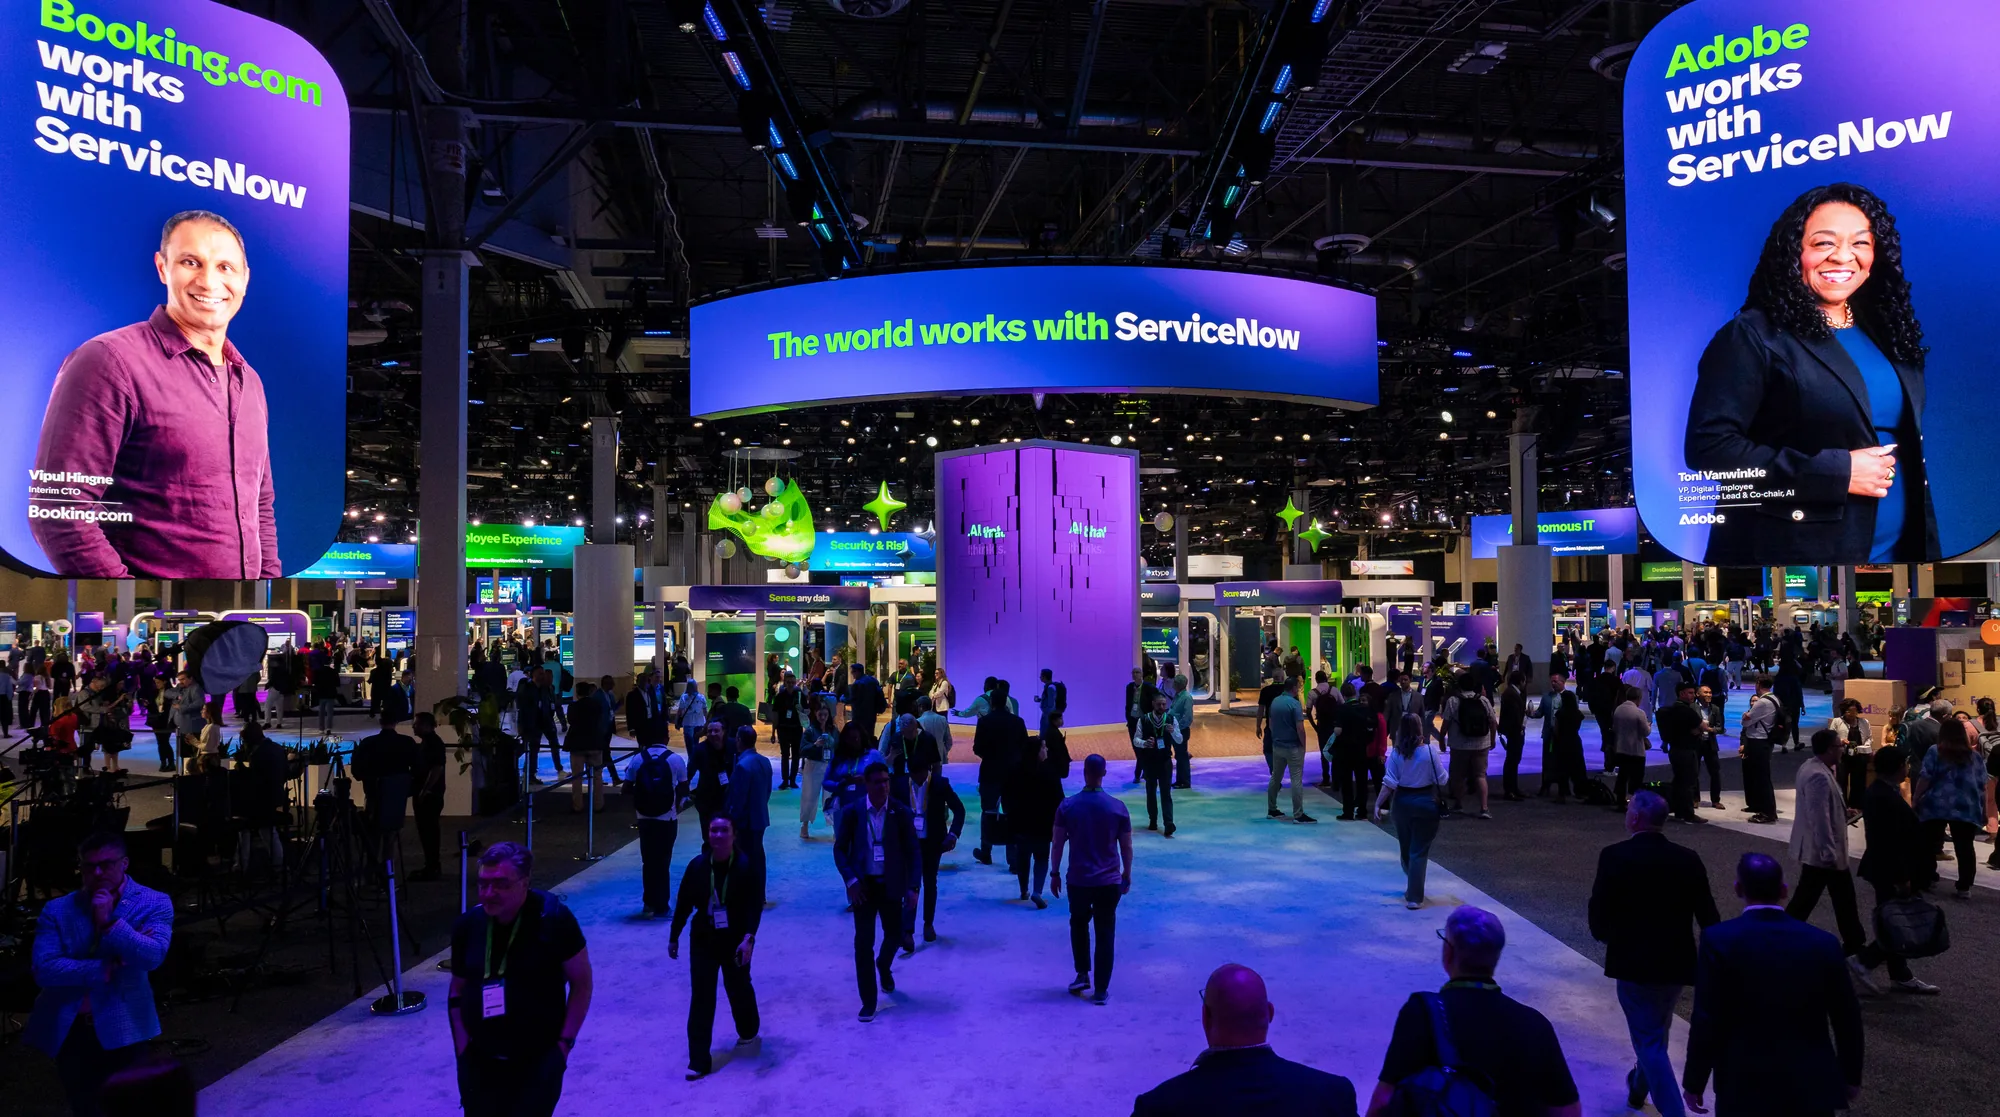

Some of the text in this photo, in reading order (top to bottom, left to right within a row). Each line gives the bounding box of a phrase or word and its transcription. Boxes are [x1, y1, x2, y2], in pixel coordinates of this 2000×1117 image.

[41, 0, 321, 107] Booking.com
[1664, 23, 1810, 79] Adobe
[37, 39, 185, 104] works
[1665, 62, 1802, 114] works
[36, 80, 142, 132] with
[1666, 104, 1761, 150] with
[1667, 110, 1952, 188] ServiceNow
[34, 115, 307, 209] ServiceNow
[767, 309, 1301, 360] The world works with ServiceNow
[28, 469, 114, 486] Vipul Hingne
[1678, 467, 1767, 482] Toni Vanwinkle
[28, 485, 81, 496] Interim CTO
[1678, 483, 1754, 495] VP, Digital Employee
[1678, 493, 1721, 503] Experience
[1721, 492, 1741, 500] Lead
[1749, 490, 1785, 499] Co-chair,
[1785, 489, 1795, 497] AI
[28, 504, 133, 523] Booking.com
[1678, 512, 1726, 526] Adobe
[1507, 519, 1596, 535] Anomous IT
[466, 532, 563, 547] loyee Experience
[830, 540, 875, 553] Security
[875, 540, 885, 551] &
[322, 550, 372, 560] ndustries
[1552, 544, 1605, 553] Operations Management
[1151, 569, 1170, 577] xtype
[768, 593, 830, 604] Sense any data
[1223, 588, 1260, 599] Secure any AI
[1977, 606, 1986, 614] EY
[1860, 704, 1887, 715] dEx
